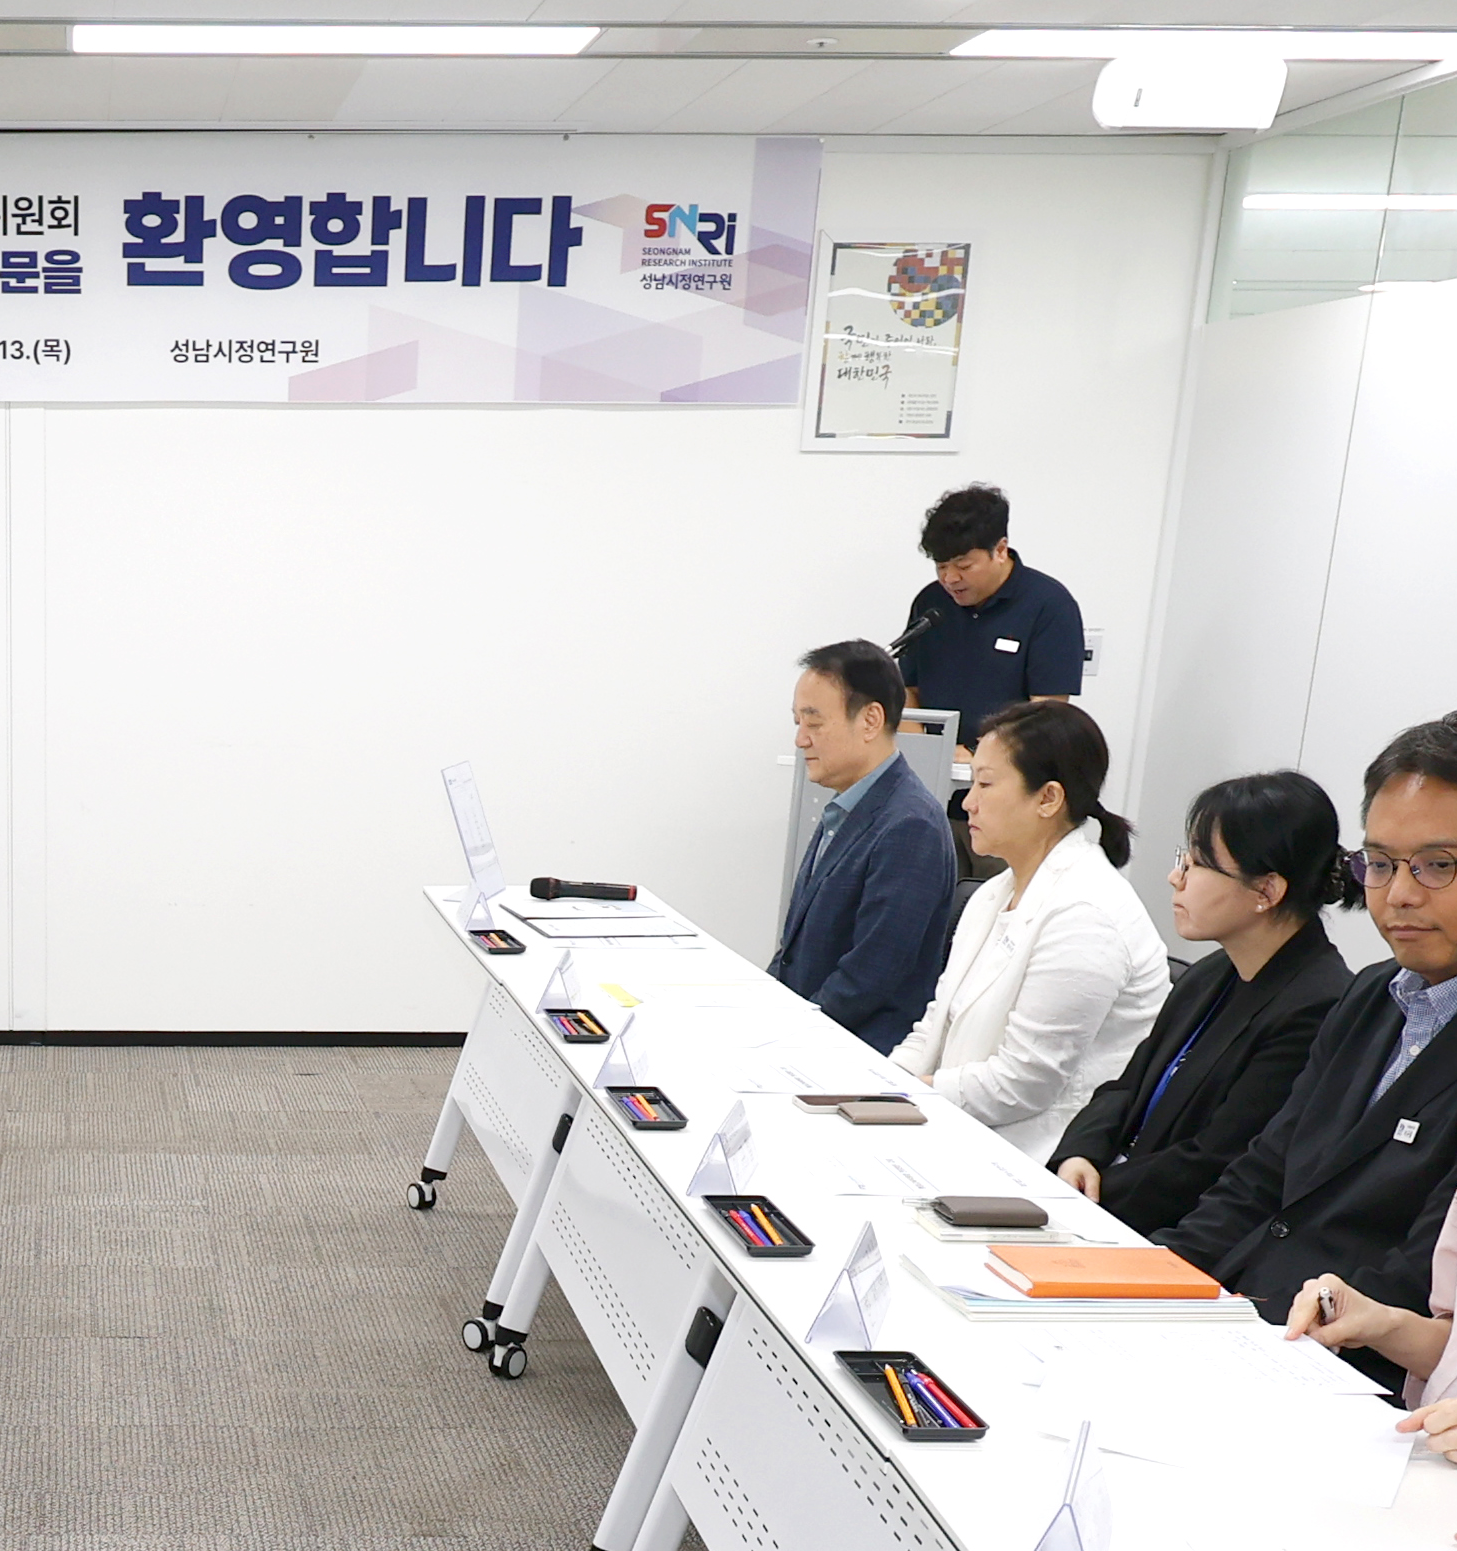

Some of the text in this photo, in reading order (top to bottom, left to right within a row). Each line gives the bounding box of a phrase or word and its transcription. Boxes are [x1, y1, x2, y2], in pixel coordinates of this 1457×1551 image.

[122, 191, 583, 291] 환영합니다
[642, 247, 691, 256] SEONGNAM
[641, 258, 733, 268] RESEARCH INSTITUTE
[640, 272, 732, 291] 성남시정연구원
[170, 339, 319, 364] 성남시정연구원
[837, 364, 892, 389] 대한민국
